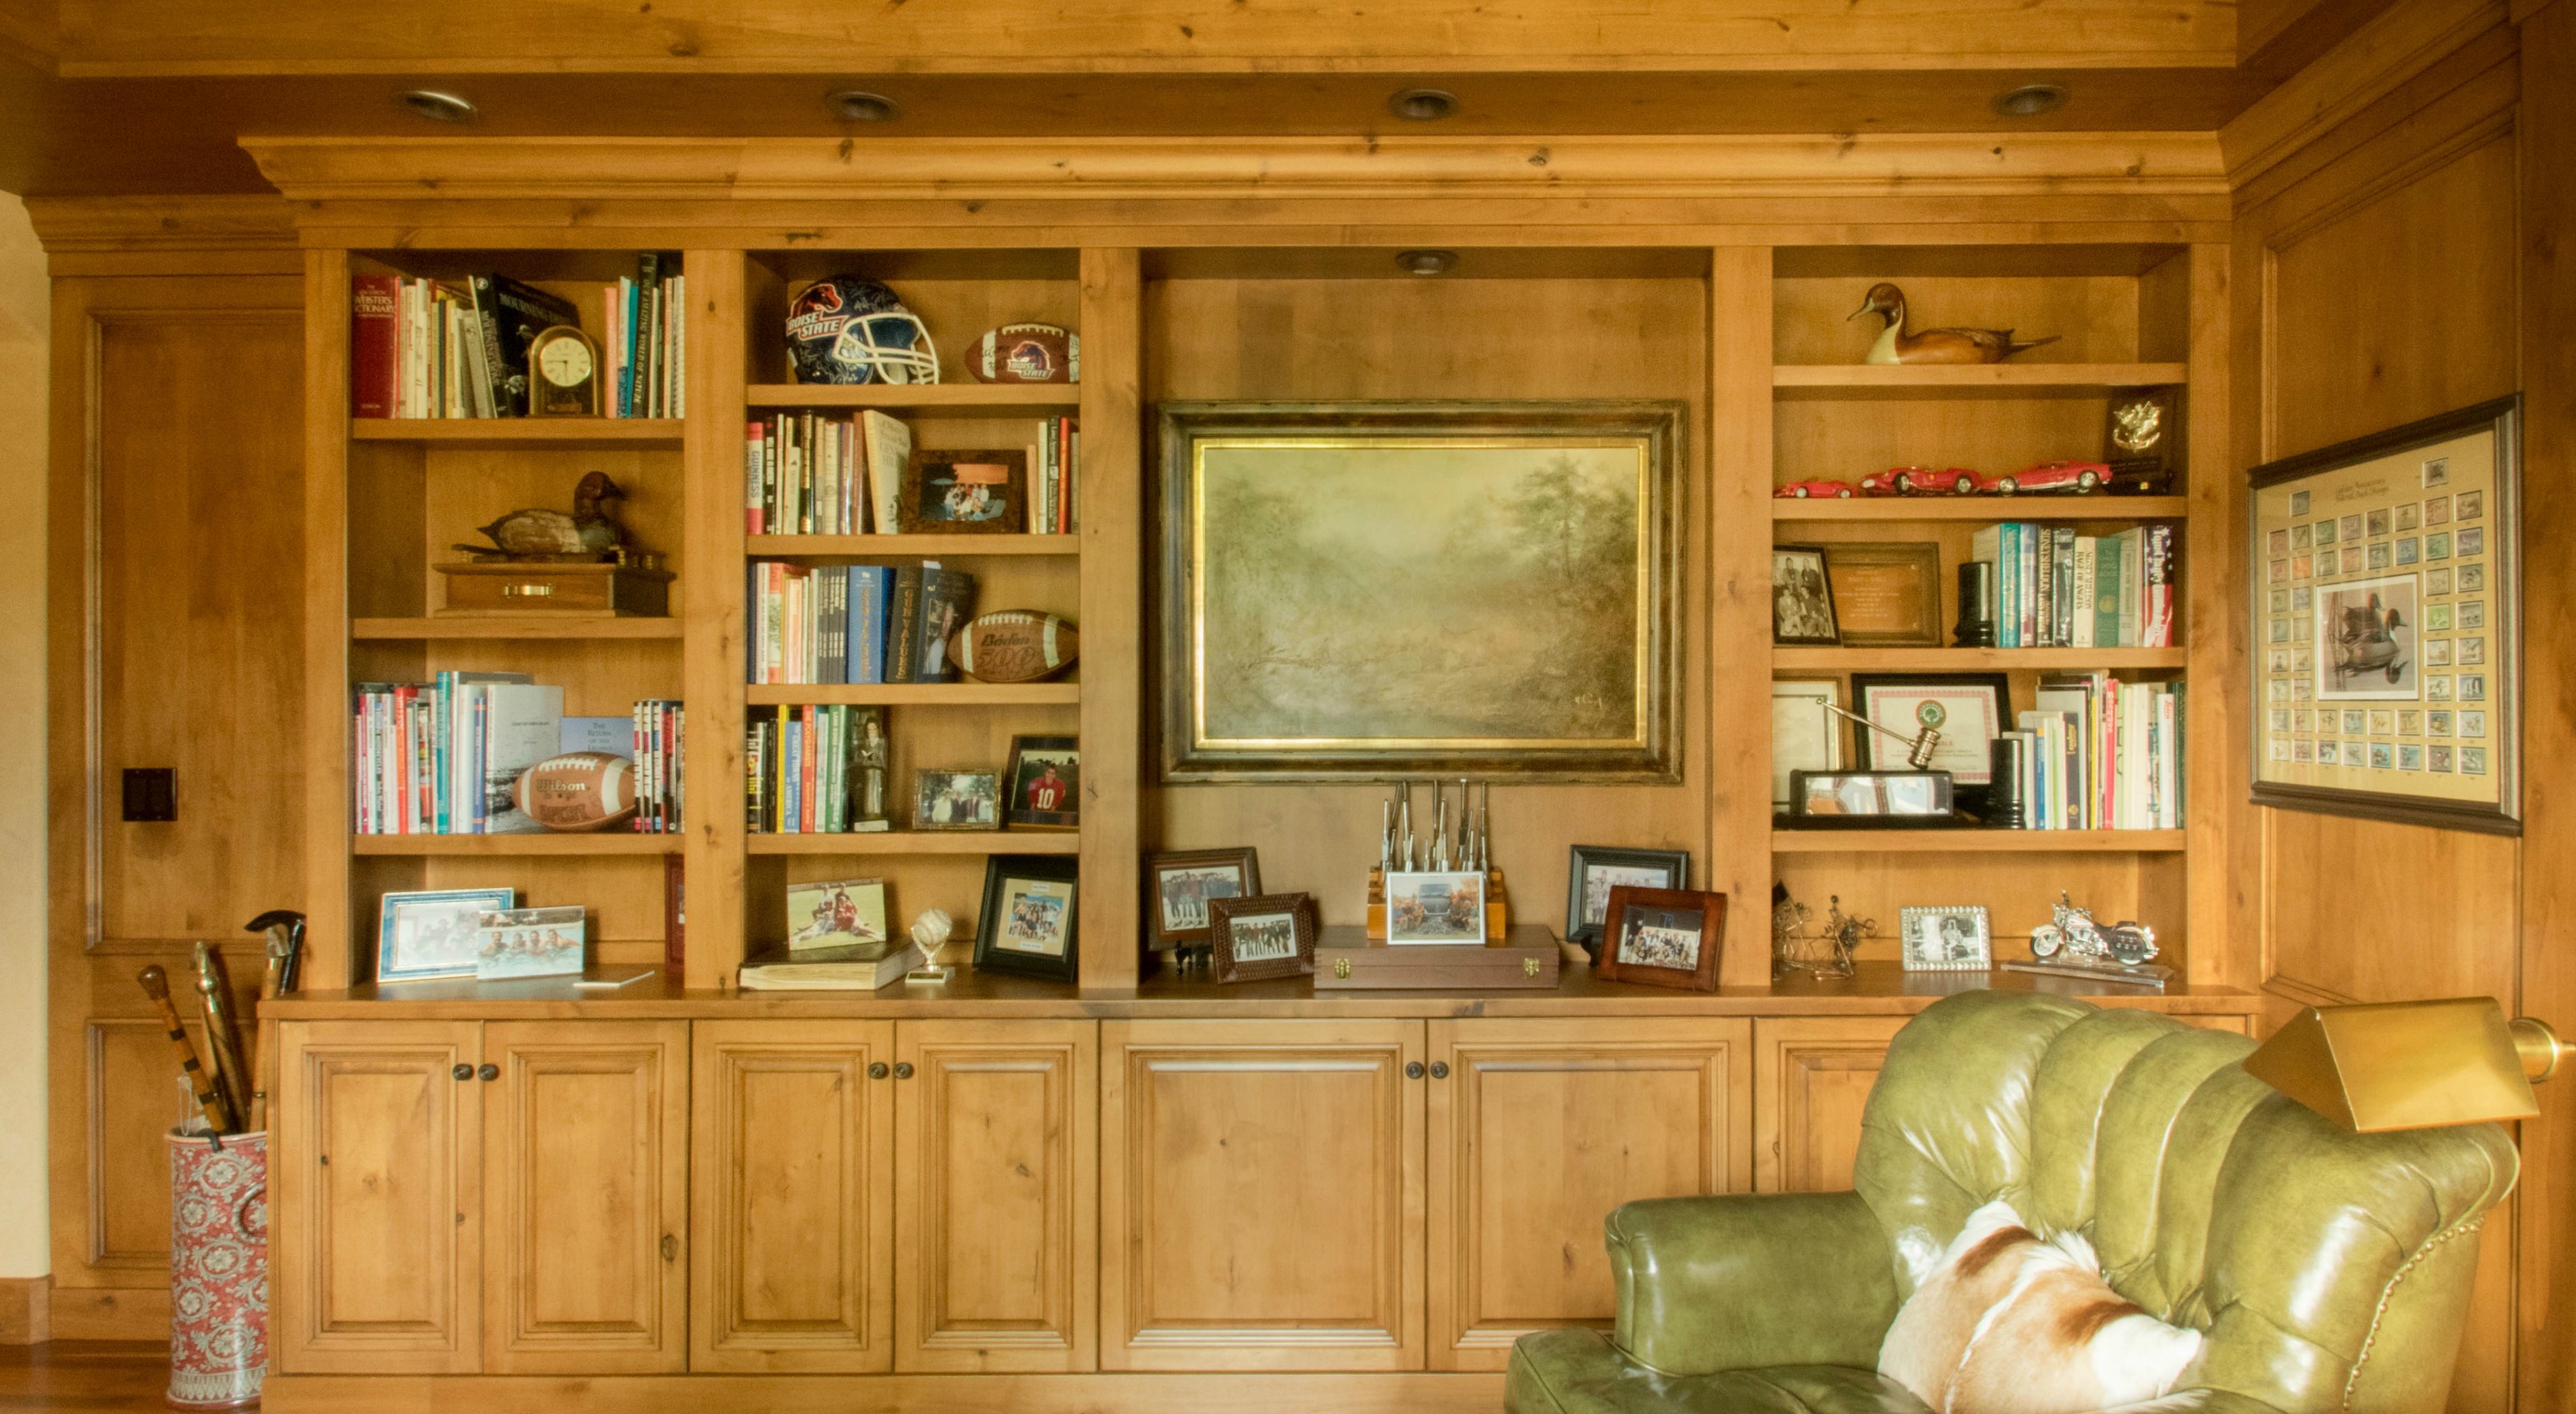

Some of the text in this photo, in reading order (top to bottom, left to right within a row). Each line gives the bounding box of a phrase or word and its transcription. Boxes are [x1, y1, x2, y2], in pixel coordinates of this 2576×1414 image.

[355, 304, 395, 313] CTIONARY
[640, 296, 650, 332] AMAZING
[788, 312, 820, 329] BOISE
[800, 320, 841, 336] STATE
[638, 334, 647, 360] WORLD
[1011, 361, 1036, 371] BOISE
[1021, 368, 1049, 378] STATE
[634, 375, 643, 405] NATURE
[751, 451, 760, 498] GUINNESS
[2040, 554, 2051, 591] SHELDON
[895, 589, 914, 680] GUN VALUES
[537, 778, 587, 792] Wilson
[1038, 788, 1055, 809] 10
